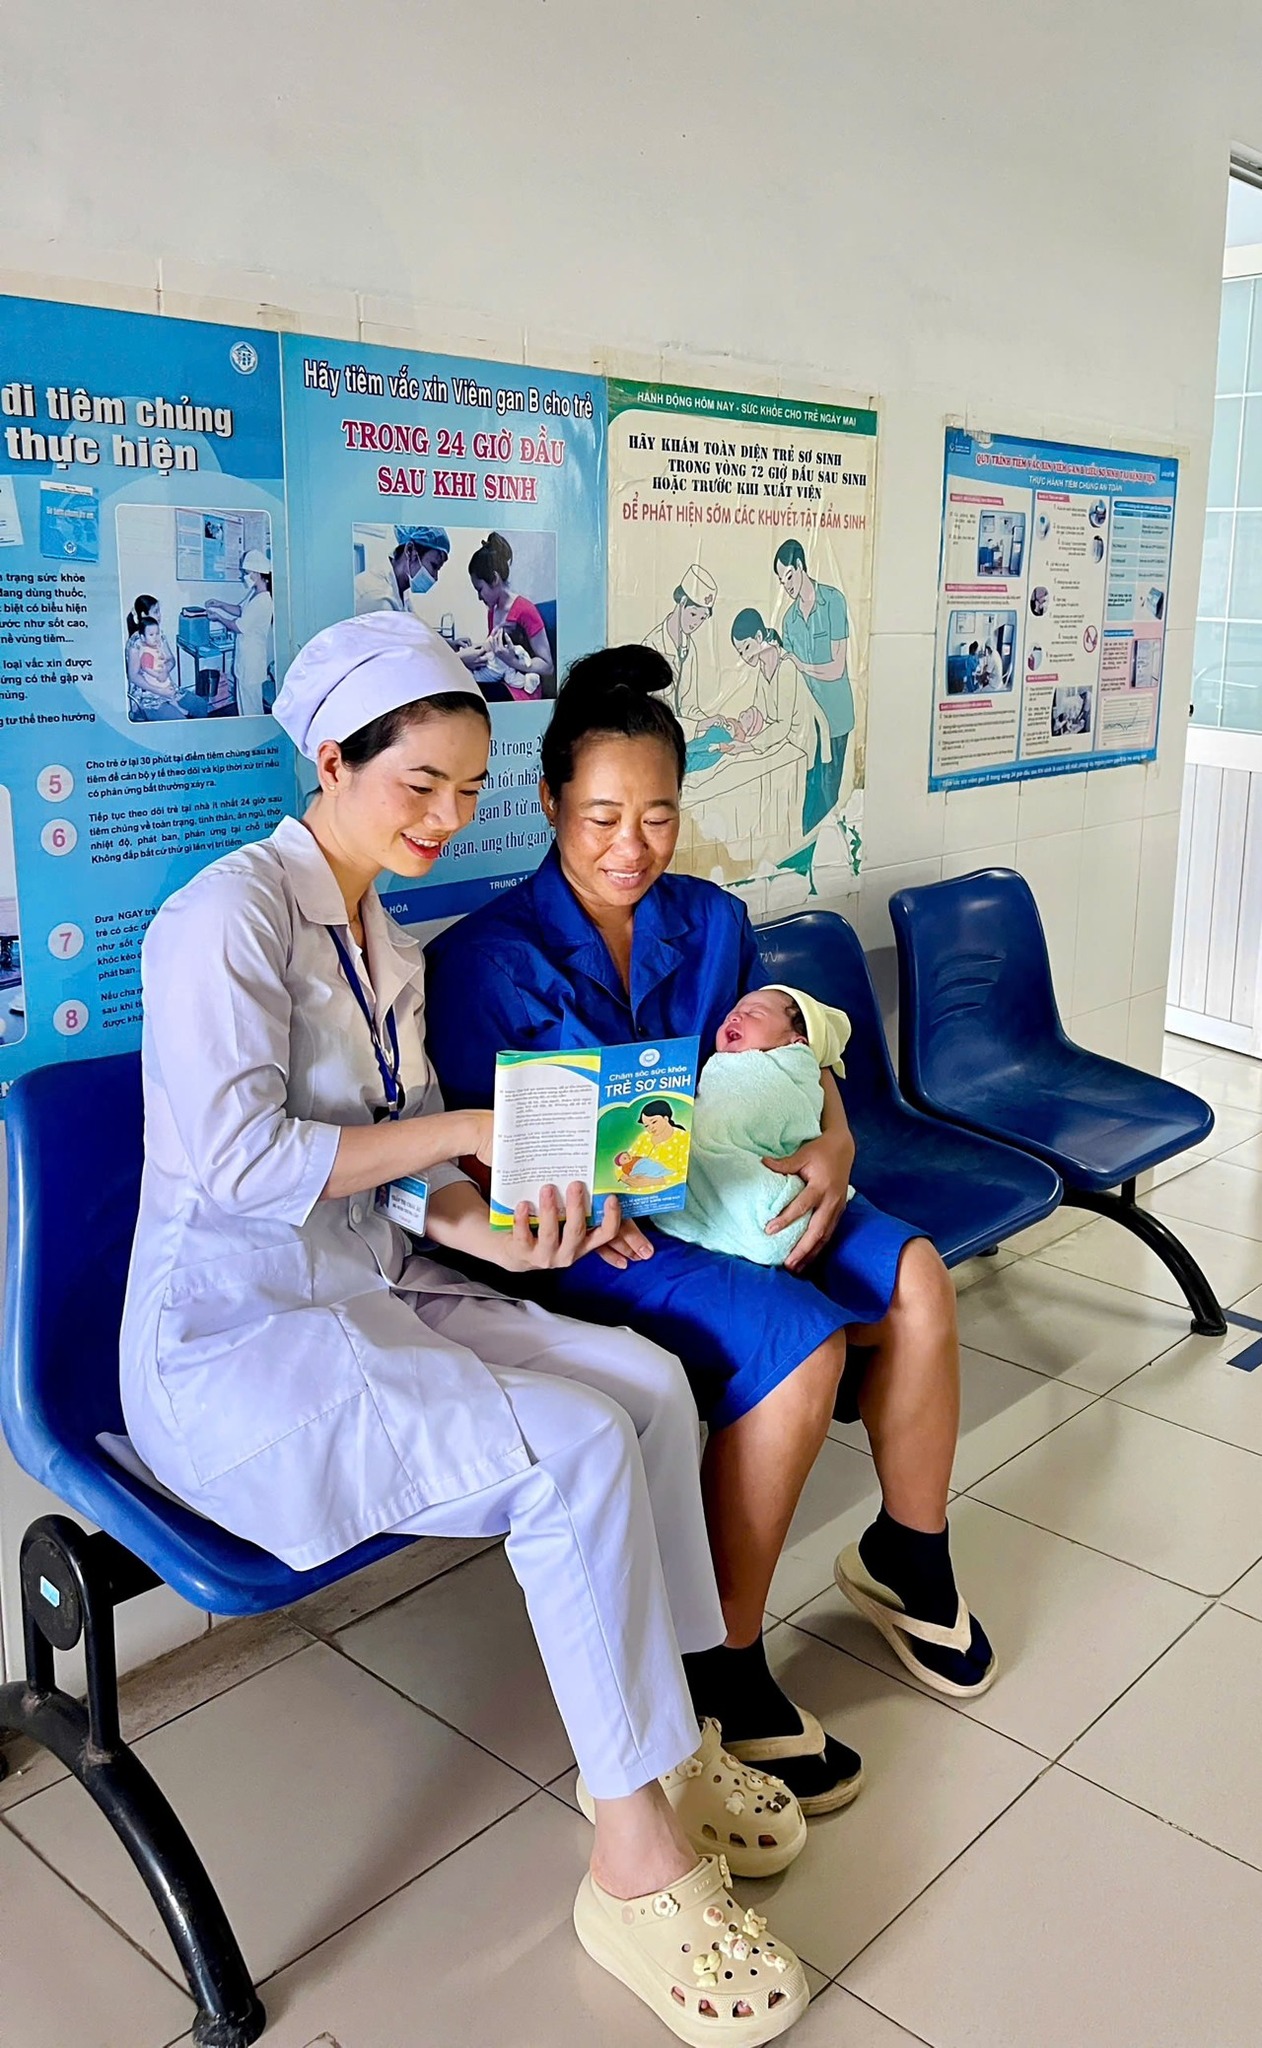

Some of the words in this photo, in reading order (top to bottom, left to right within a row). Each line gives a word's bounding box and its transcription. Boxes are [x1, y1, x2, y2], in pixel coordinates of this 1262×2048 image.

[303, 358, 341, 398] Hãy
[345, 365, 384, 397] tiêm
[388, 365, 420, 400] vắc
[423, 376, 448, 403] xin
[452, 377, 492, 408] Viêm
[496, 390, 524, 415] gan
[528, 388, 540, 413] B
[543, 392, 570, 417] cho
[573, 393, 594, 418] trẻ
[1, 382, 35, 417] đi
[46, 387, 125, 425] tiêm
[136, 395, 232, 437] chủng
[637, 391, 664, 405] HÀNH
[665, 393, 692, 409] ĐỘNG
[694, 395, 715, 411] HÔM
[716, 399, 734, 412] NAY
[741, 403, 759, 415] SỨC
[760, 403, 783, 418] KHỎE
[784, 408, 801, 420] CHO
[803, 408, 819, 422] TRẺ
[819, 411, 841, 425] NGÀY
[842, 414, 856, 426] MAI
[4, 427, 99, 470] thực
[112, 434, 198, 476] hiện
[342, 420, 429, 454] TRONG
[437, 430, 465, 458] 24
[473, 428, 513, 462] GIỜ
[520, 426, 565, 467] ĐẦU
[628, 432, 655, 450] HÃY
[661, 435, 699, 454] KHÁM
[703, 439, 736, 457] TOÀN
[740, 443, 768, 463] DIỆN
[772, 444, 795, 462] TRẺ
[798, 449, 813, 463] SƠ
[816, 452, 842, 466] SINH
[668, 459, 711, 474] TRONG
[715, 461, 747, 478] VÒNG
[751, 465, 764, 478] 72
[768, 463, 788, 481] GIỜ
[792, 463, 814, 482] ĐẦU
[818, 471, 838, 484] SAU
[842, 473, 867, 487] SINH
[377, 466, 425, 496] SAU
[433, 470, 477, 498] KHI
[484, 474, 537, 502] SINH
[652, 474, 687, 495] HOẶC
[692, 477, 732, 494] TRƯỚC
[737, 482, 759, 495] KHI
[763, 480, 793, 498] XUẤT
[797, 486, 822, 501] VIỆN
[623, 491, 639, 520] ĐỂ
[642, 499, 673, 522] PHÁT
[676, 501, 703, 527] HIỆN
[706, 504, 731, 524] SỚM
[734, 505, 755, 526] CÁC
[758, 503, 798, 527] KHUYẾT
[800, 511, 818, 532] TẬT
[820, 503, 841, 529] BẨM
[843, 515, 866, 530] SINH
[6, 573, 34, 584] trạng
[37, 573, 57, 582] sức
[60, 573, 85, 582] khỏe
[25, 588, 52, 599] dùng
[54, 586, 86, 598] thuốc,
[3, 603, 24, 614] biệt
[26, 603, 39, 612] có
[41, 602, 63, 612] biểu
[65, 603, 87, 614] hiện
[24, 619, 45, 627] như
[48, 616, 64, 627] sốt
[67, 620, 88, 628] cao,
[15, 634, 41, 645] vùng
[3, 659, 22, 671] loại
[25, 657, 43, 668] vắc
[47, 659, 62, 668] xin
[65, 658, 92, 668] được
[25, 674, 38, 683] có
[41, 672, 57, 683] thể
[60, 672, 79, 684] gặp
[81, 672, 93, 681] và
[5, 716, 18, 725] tư
[19, 713, 36, 724] thế
[37, 714, 60, 723] theo
[61, 712, 96, 722] hướng
[86, 760, 105, 769] Cho
[106, 758, 118, 767] trẻ
[128, 757, 139, 767] lại
[140, 756, 151, 765] 30
[152, 755, 172, 765] phút
[172, 753, 183, 762] tại
[185, 751, 205, 761] điểm
[206, 750, 224, 759] tiêm
[225, 749, 250, 759] chủng
[251, 748, 266, 756] sau
[267, 747, 279, 755] khi
[502, 741, 533, 758] trong
[49, 774, 62, 794] 5
[498, 768, 513, 788] tốt
[88, 789, 99, 798] có
[101, 786, 123, 798] phản
[124, 785, 141, 795] ứng
[143, 783, 158, 793] bất
[158, 781, 190, 791] thường
[479, 806, 499, 825] gan
[504, 801, 511, 817] B
[515, 798, 528, 816] từ
[52, 828, 66, 848] 6
[453, 841, 478, 861] gan,
[482, 837, 502, 854] ung
[506, 831, 525, 848] thư
[527, 831, 547, 850] gan
[489, 879, 517, 890] TRUNG
[95, 915, 114, 924] Đưa
[118, 909, 143, 920] NGAY
[59, 932, 72, 952] 7
[97, 943, 115, 952] như
[119, 939, 133, 948] sốt
[97, 955, 119, 966] khóc
[120, 953, 136, 961] kéo
[65, 1009, 78, 1029] 8
[605, 1079, 631, 1098] TRẺ
[635, 1078, 657, 1092] SƠ
[659, 1074, 691, 1089] SINH
